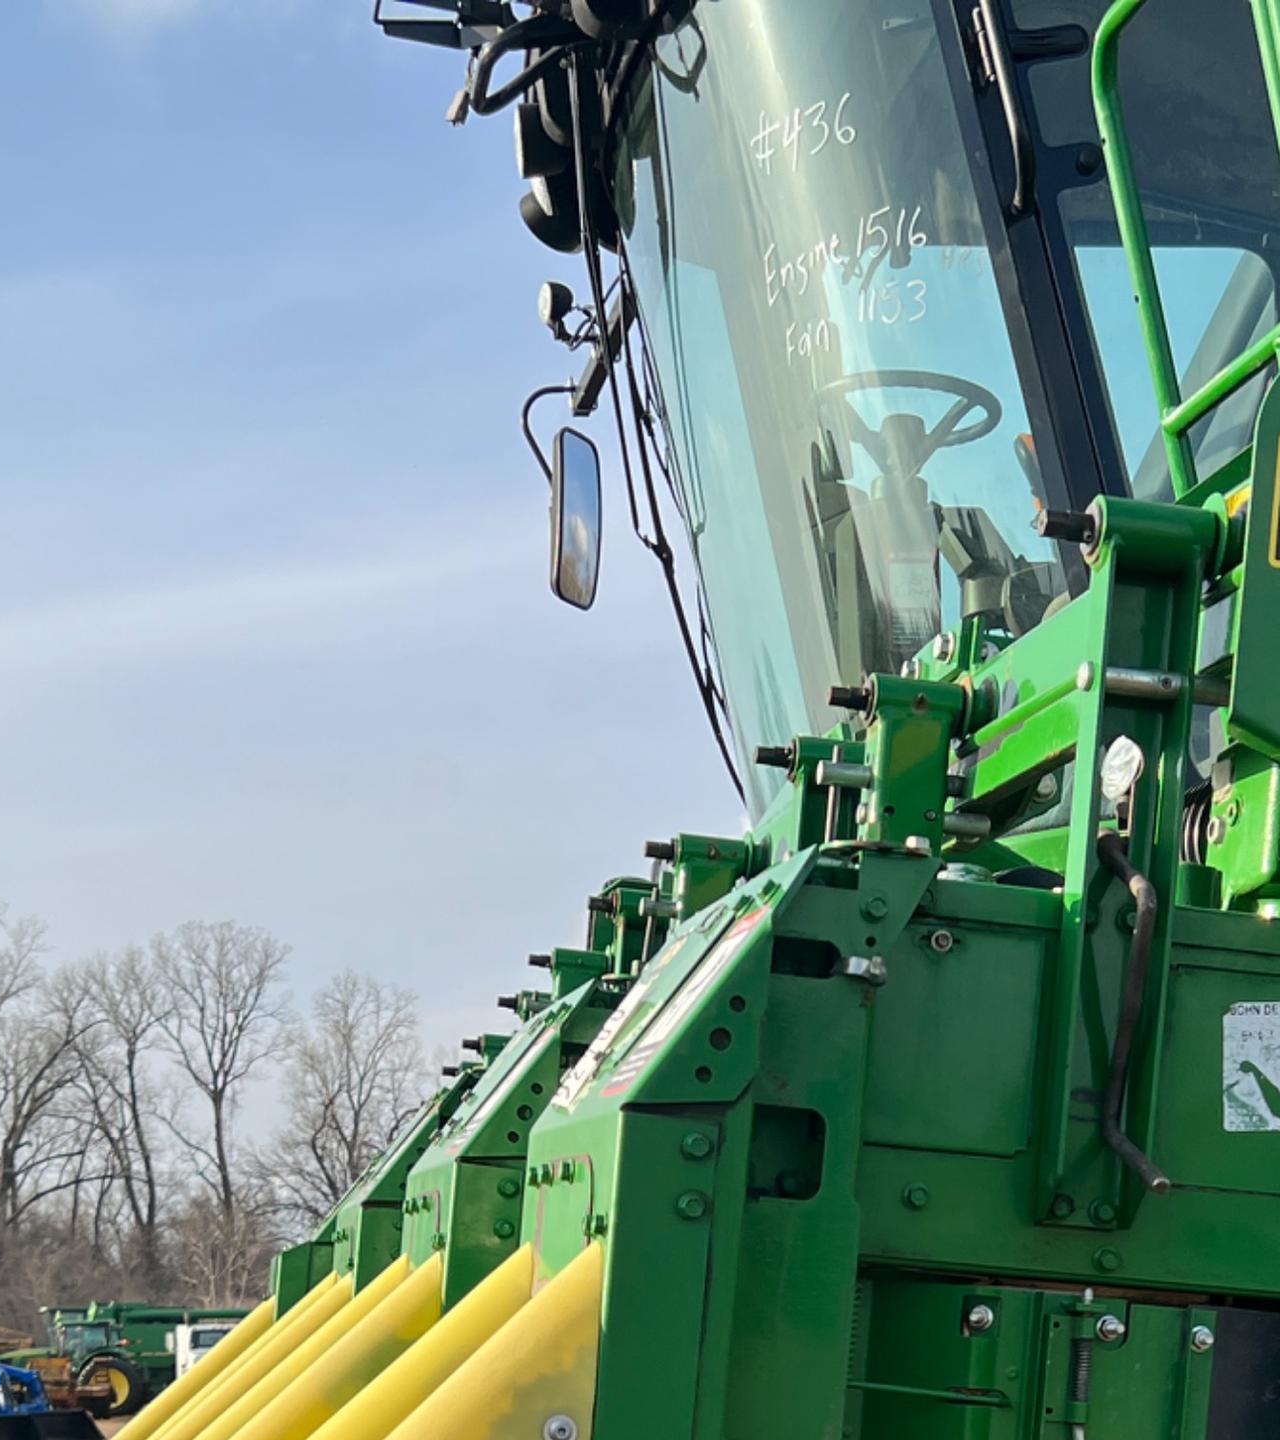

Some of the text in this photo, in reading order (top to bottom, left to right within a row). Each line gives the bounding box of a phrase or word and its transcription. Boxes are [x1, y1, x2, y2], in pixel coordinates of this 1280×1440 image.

[750, 92, 856, 174] #436
[856, 205, 928, 258] 1516
[858, 279, 927, 325] 1153
